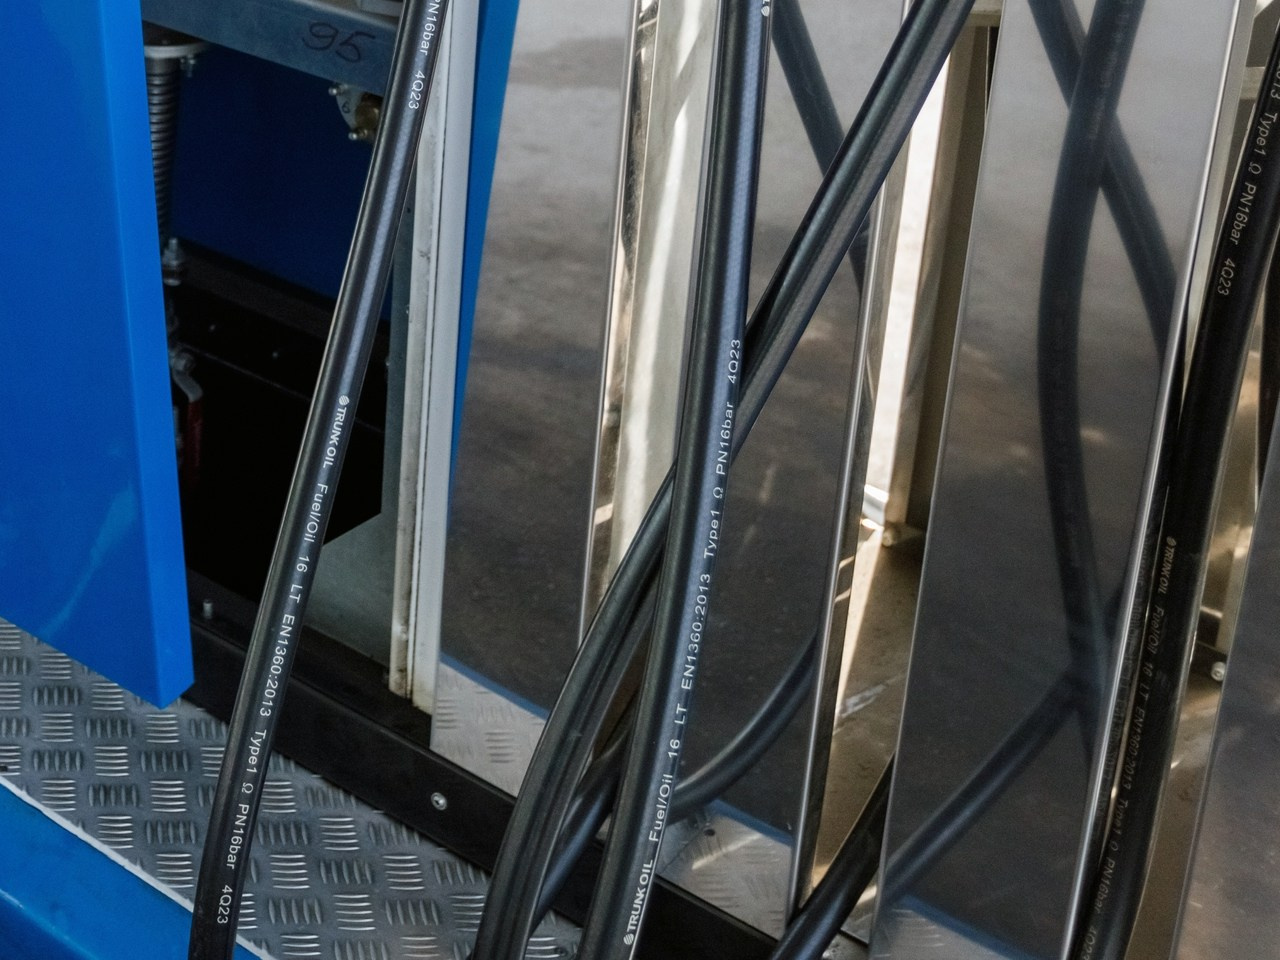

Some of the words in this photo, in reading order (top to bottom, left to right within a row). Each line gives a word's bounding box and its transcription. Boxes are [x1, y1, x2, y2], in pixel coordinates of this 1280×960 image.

[302, 22, 376, 63] 95
[408, 70, 426, 110] 4Q23
[1253, 112, 1278, 156] Type1
[1230, 181, 1257, 246] PN16bar
[1217, 257, 1236, 296] 4Q23
[329, 407, 347, 446] TRUNK
[322, 447, 337, 469] OIL
[303, 483, 329, 543] Fuel/Oil
[296, 555, 310, 573] 16
[289, 583, 303, 604] LT
[626, 887, 646, 932] TRUNK
[639, 859, 653, 886] OIL
[648, 773, 673, 841] Fuel/Oil
[667, 739, 681, 758] 16
[674, 703, 687, 725] LT
[681, 573, 711, 690] EN1360:2013
[703, 509, 720, 559] Type1
[716, 401, 734, 475] PN16bar
[727, 339, 741, 384] 4Q23
[259, 614, 295, 717] EN1360:2013
[246, 729, 267, 774] Type1
[226, 803, 250, 870] PN16bar
[216, 884, 233, 924] 4Q23
